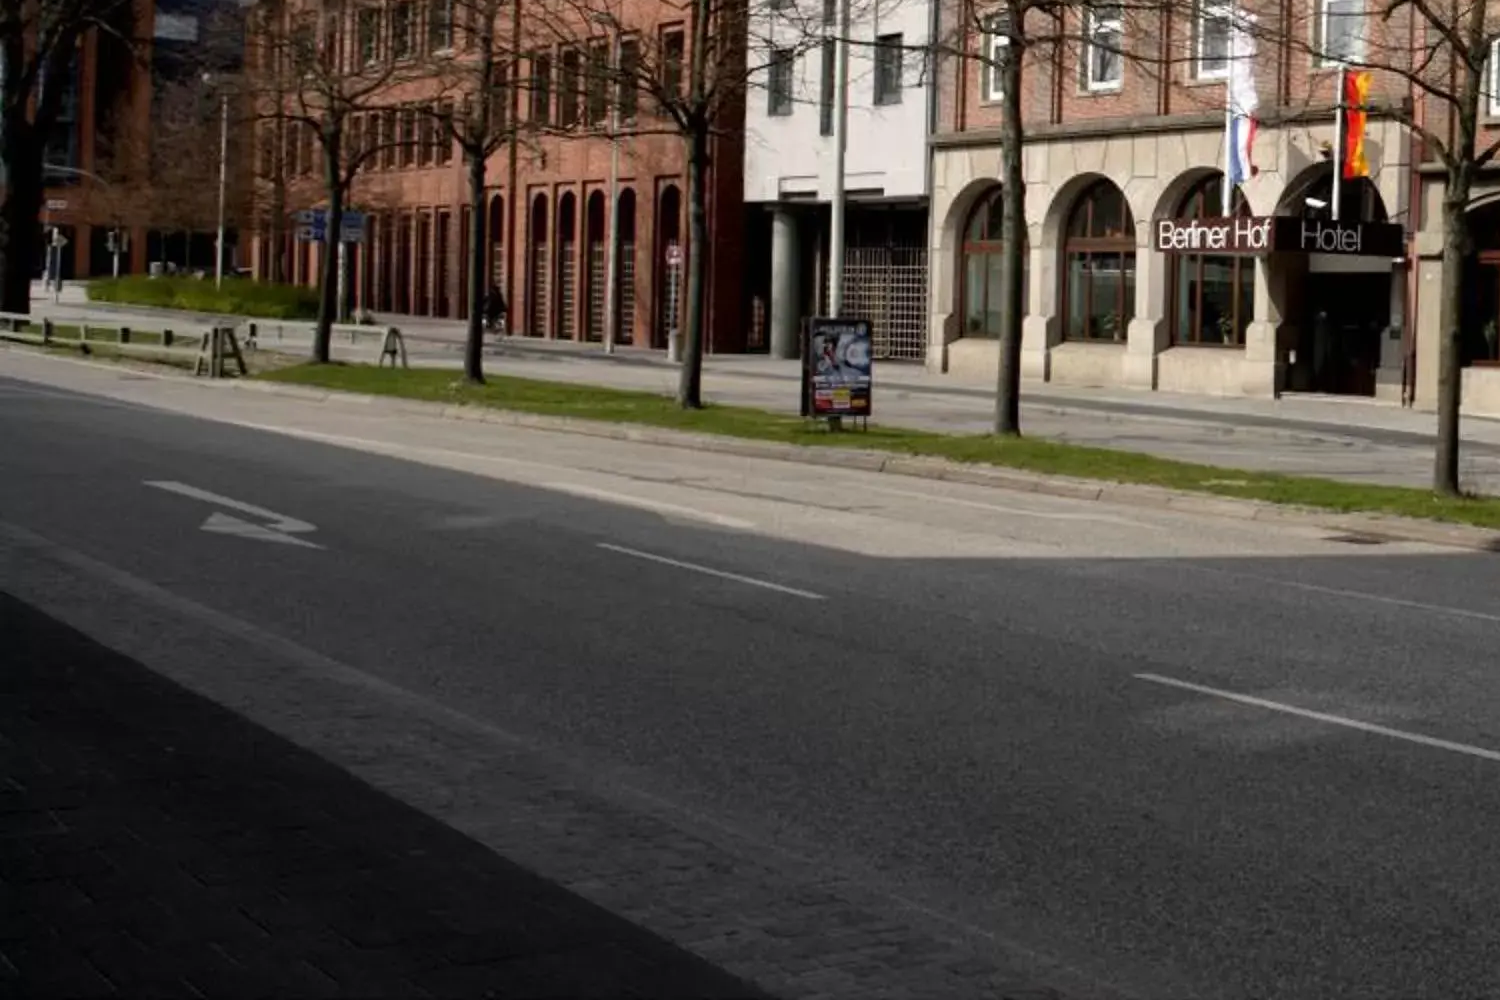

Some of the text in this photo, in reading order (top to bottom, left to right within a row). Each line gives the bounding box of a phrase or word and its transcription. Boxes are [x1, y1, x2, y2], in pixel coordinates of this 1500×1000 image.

[1159, 218, 1271, 249] Berliner Hof
[1301, 221, 1362, 252] Hotel
